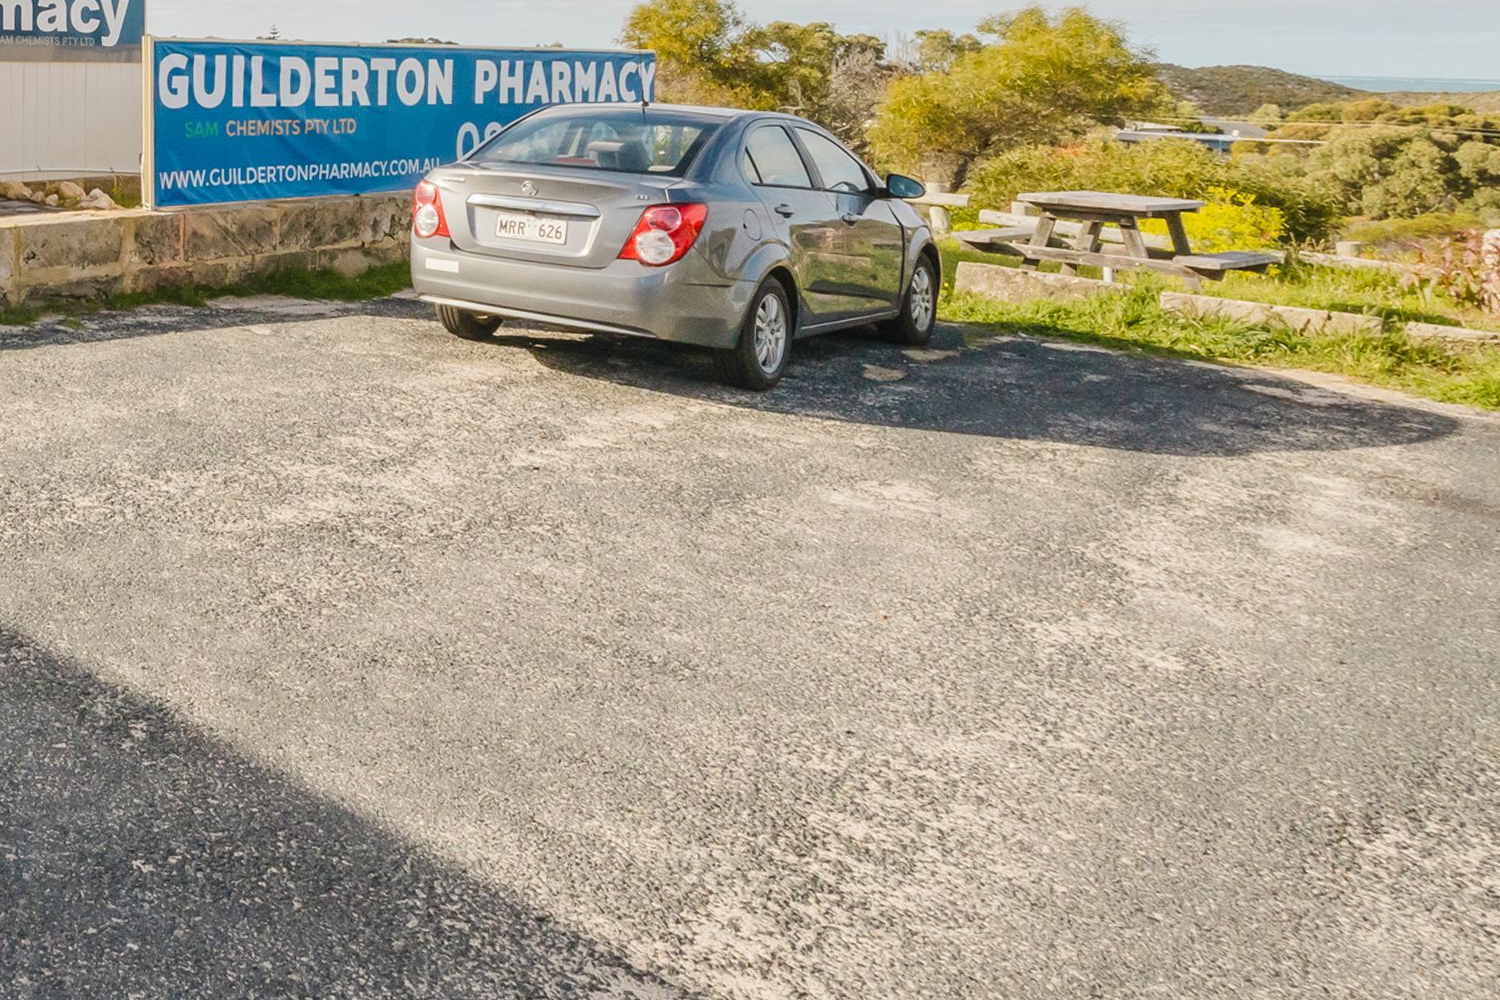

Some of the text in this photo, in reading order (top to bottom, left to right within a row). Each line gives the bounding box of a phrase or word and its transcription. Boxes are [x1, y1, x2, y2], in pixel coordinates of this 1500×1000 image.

[15, 35, 60, 46] CHEMISTS
[62, 36, 79, 46] PTY
[80, 37, 95, 47] LTD
[158, 53, 656, 109] GUILDERTON PHARMACY
[185, 118, 357, 138] SAM CHEMISTS PTY LTD
[159, 157, 440, 189] WWW.GUILDERTONPHARMACY.COM.AU
[498, 219, 563, 240] MRR 626
